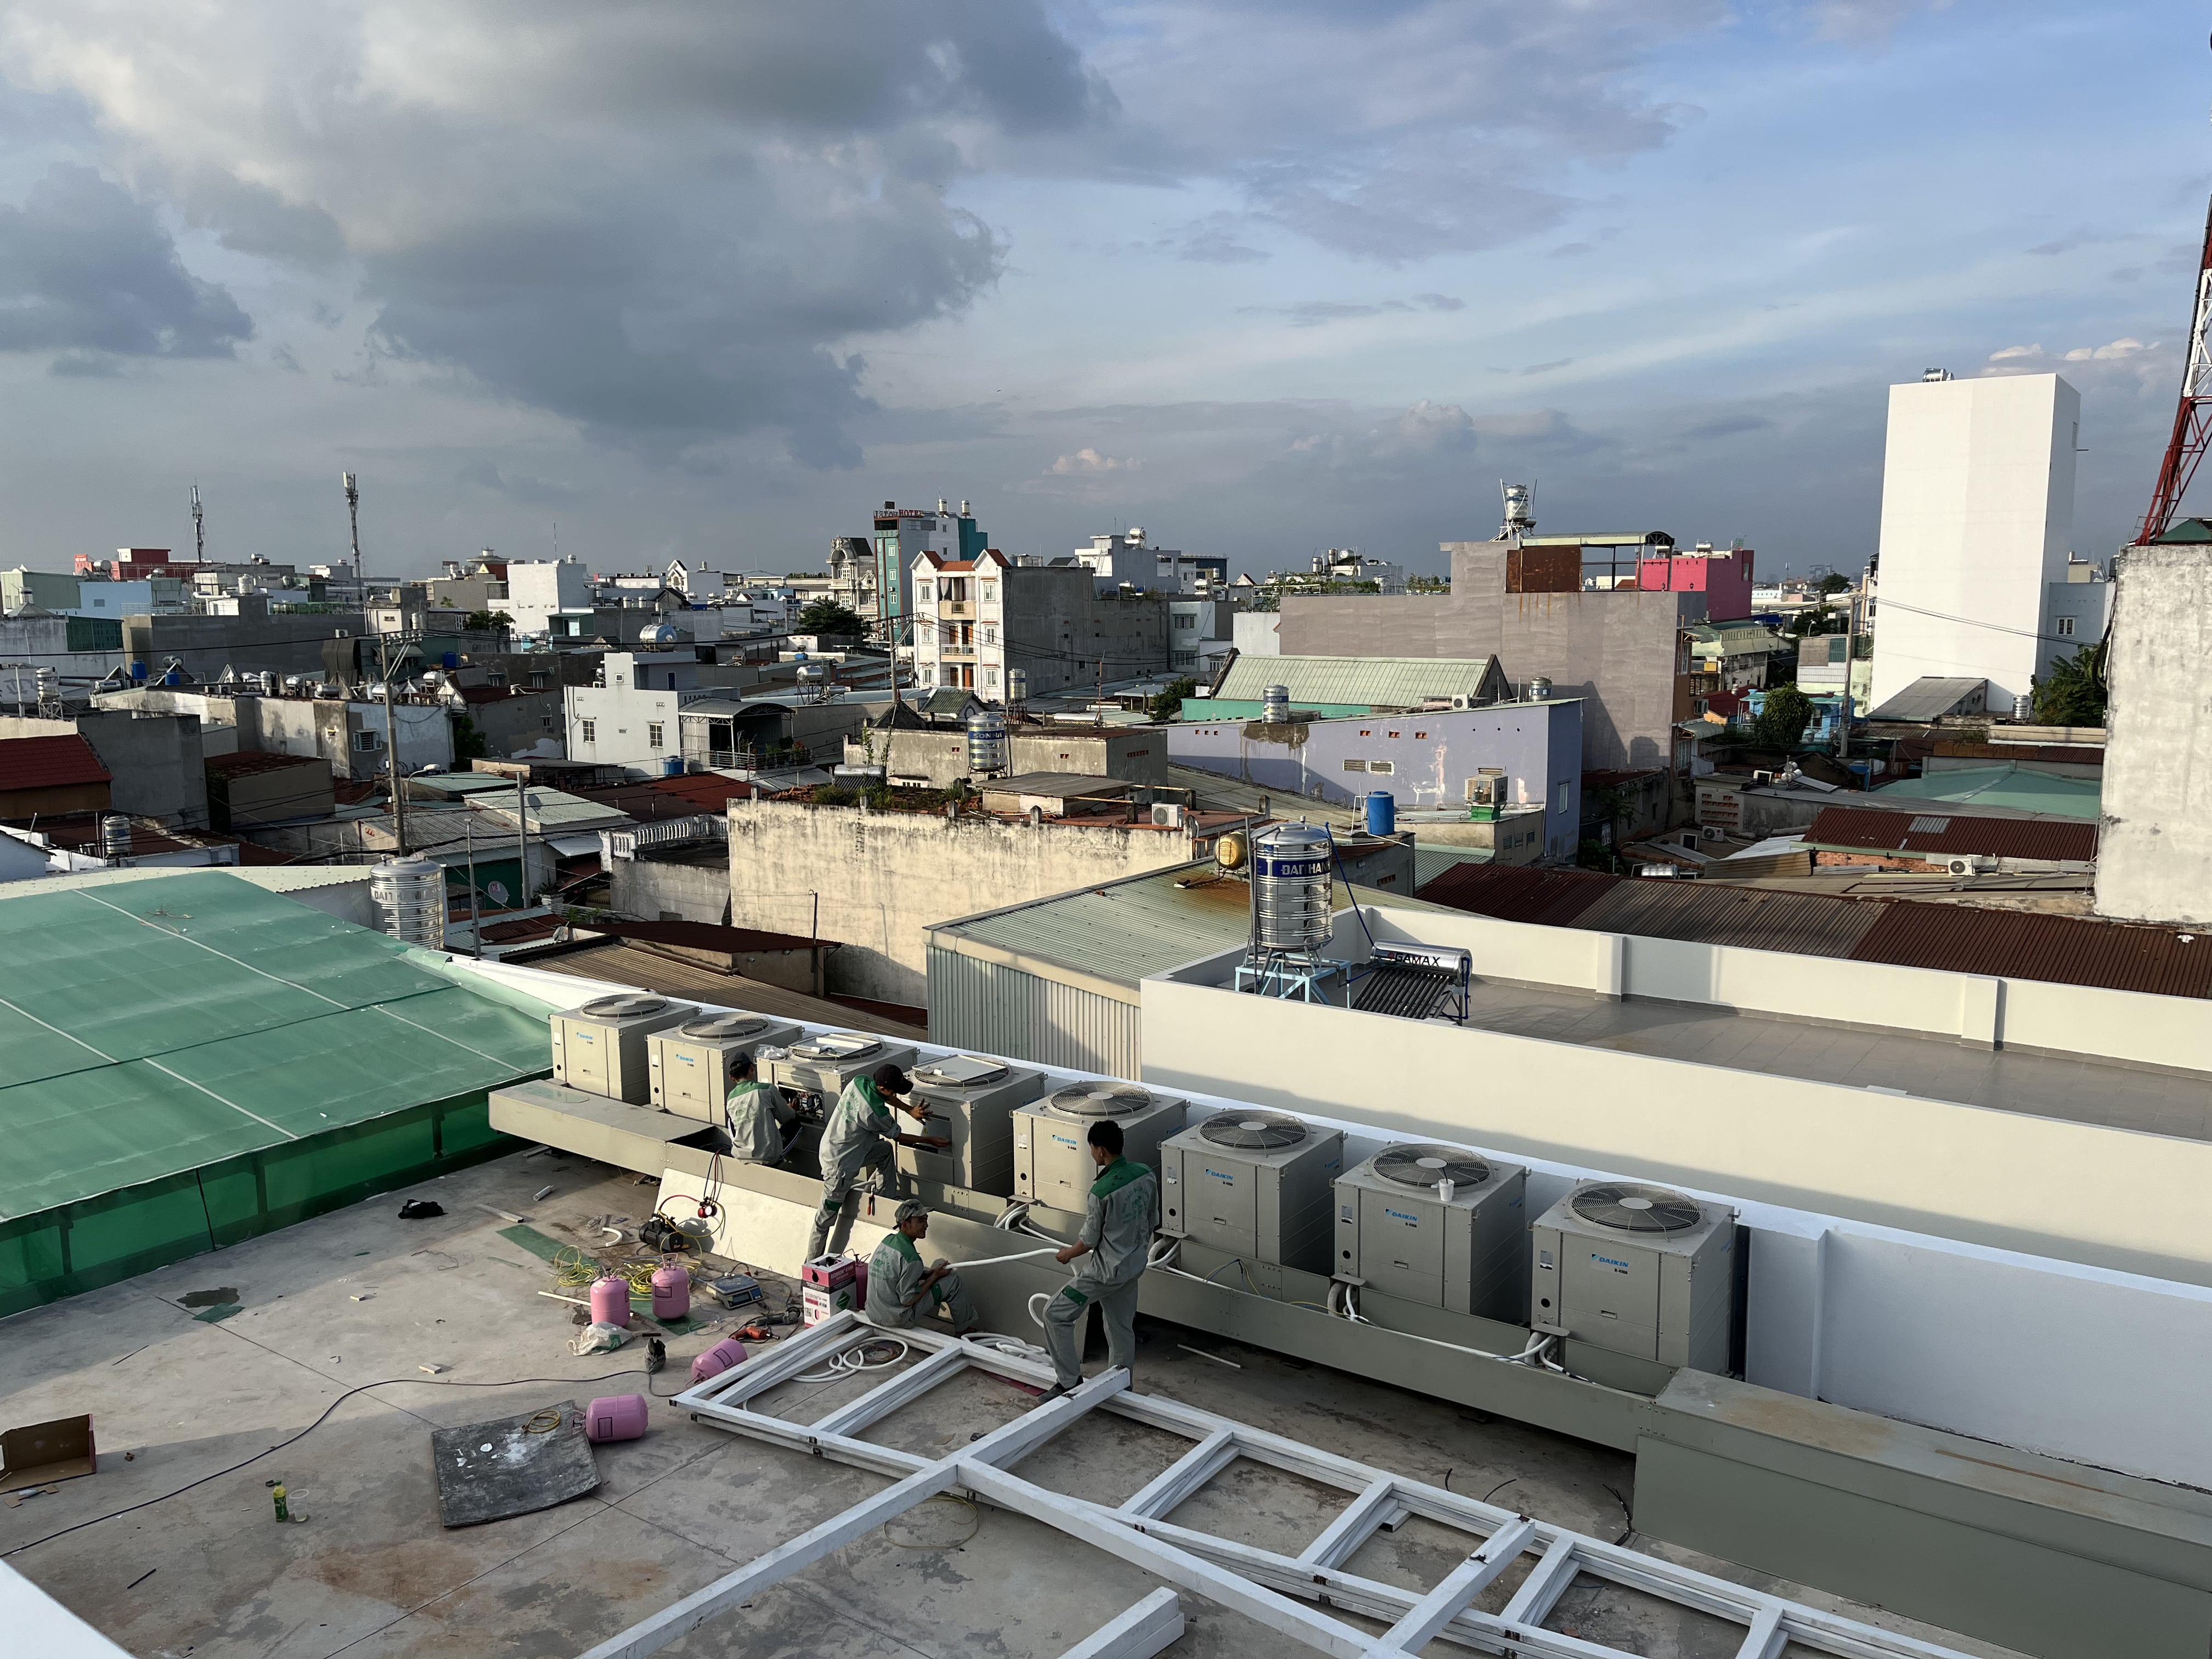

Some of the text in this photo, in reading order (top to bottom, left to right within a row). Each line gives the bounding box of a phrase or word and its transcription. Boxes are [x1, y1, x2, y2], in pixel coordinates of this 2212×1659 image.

[899, 509, 924, 517] HOTEL
[1057, 1137, 1077, 1145] DAIKIN
[1211, 1171, 1233, 1180] DAIKIN
[1392, 1212, 1418, 1221] DAIKIN
[1599, 1257, 1628, 1267] DAIKIN
